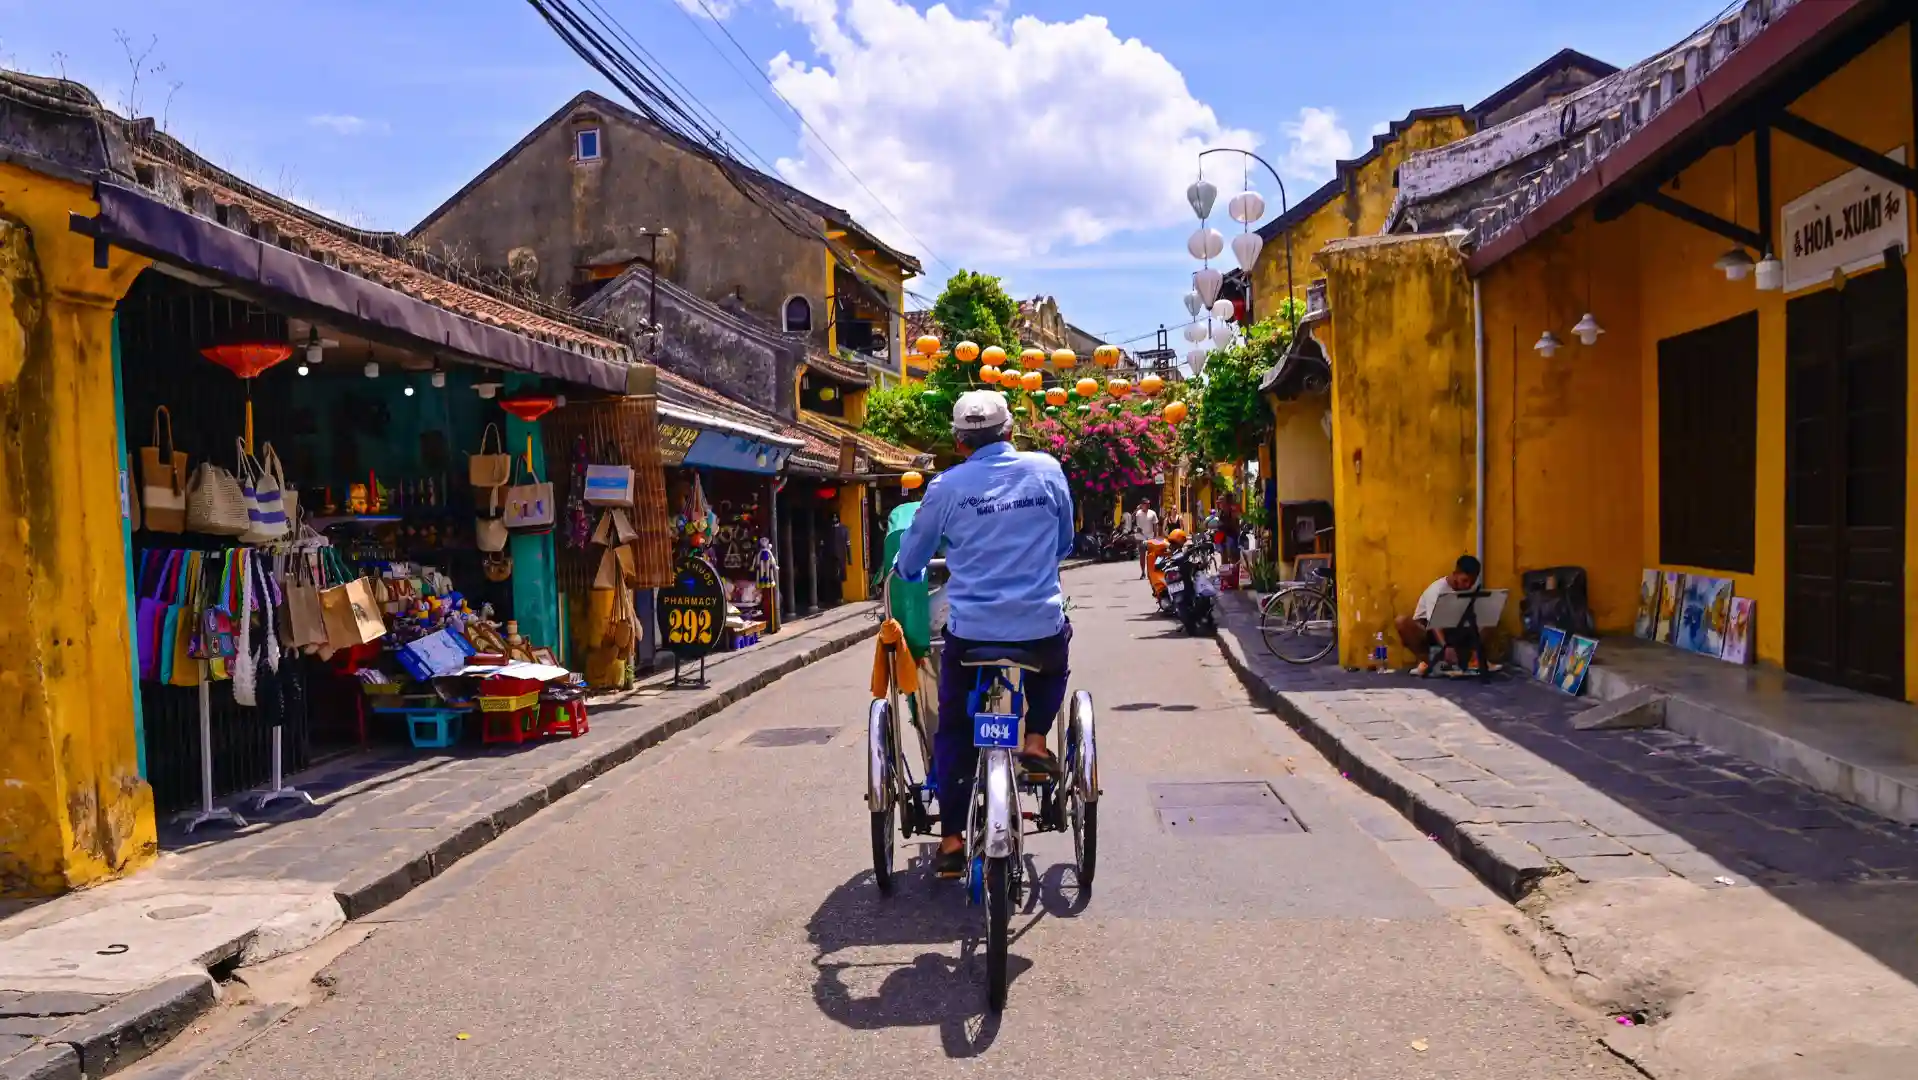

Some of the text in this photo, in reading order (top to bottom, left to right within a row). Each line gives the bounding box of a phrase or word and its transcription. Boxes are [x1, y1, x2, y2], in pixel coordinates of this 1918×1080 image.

[664, 596, 717, 606] PHARMACY
[668, 608, 713, 644] 292
[980, 722, 1011, 739] 084
